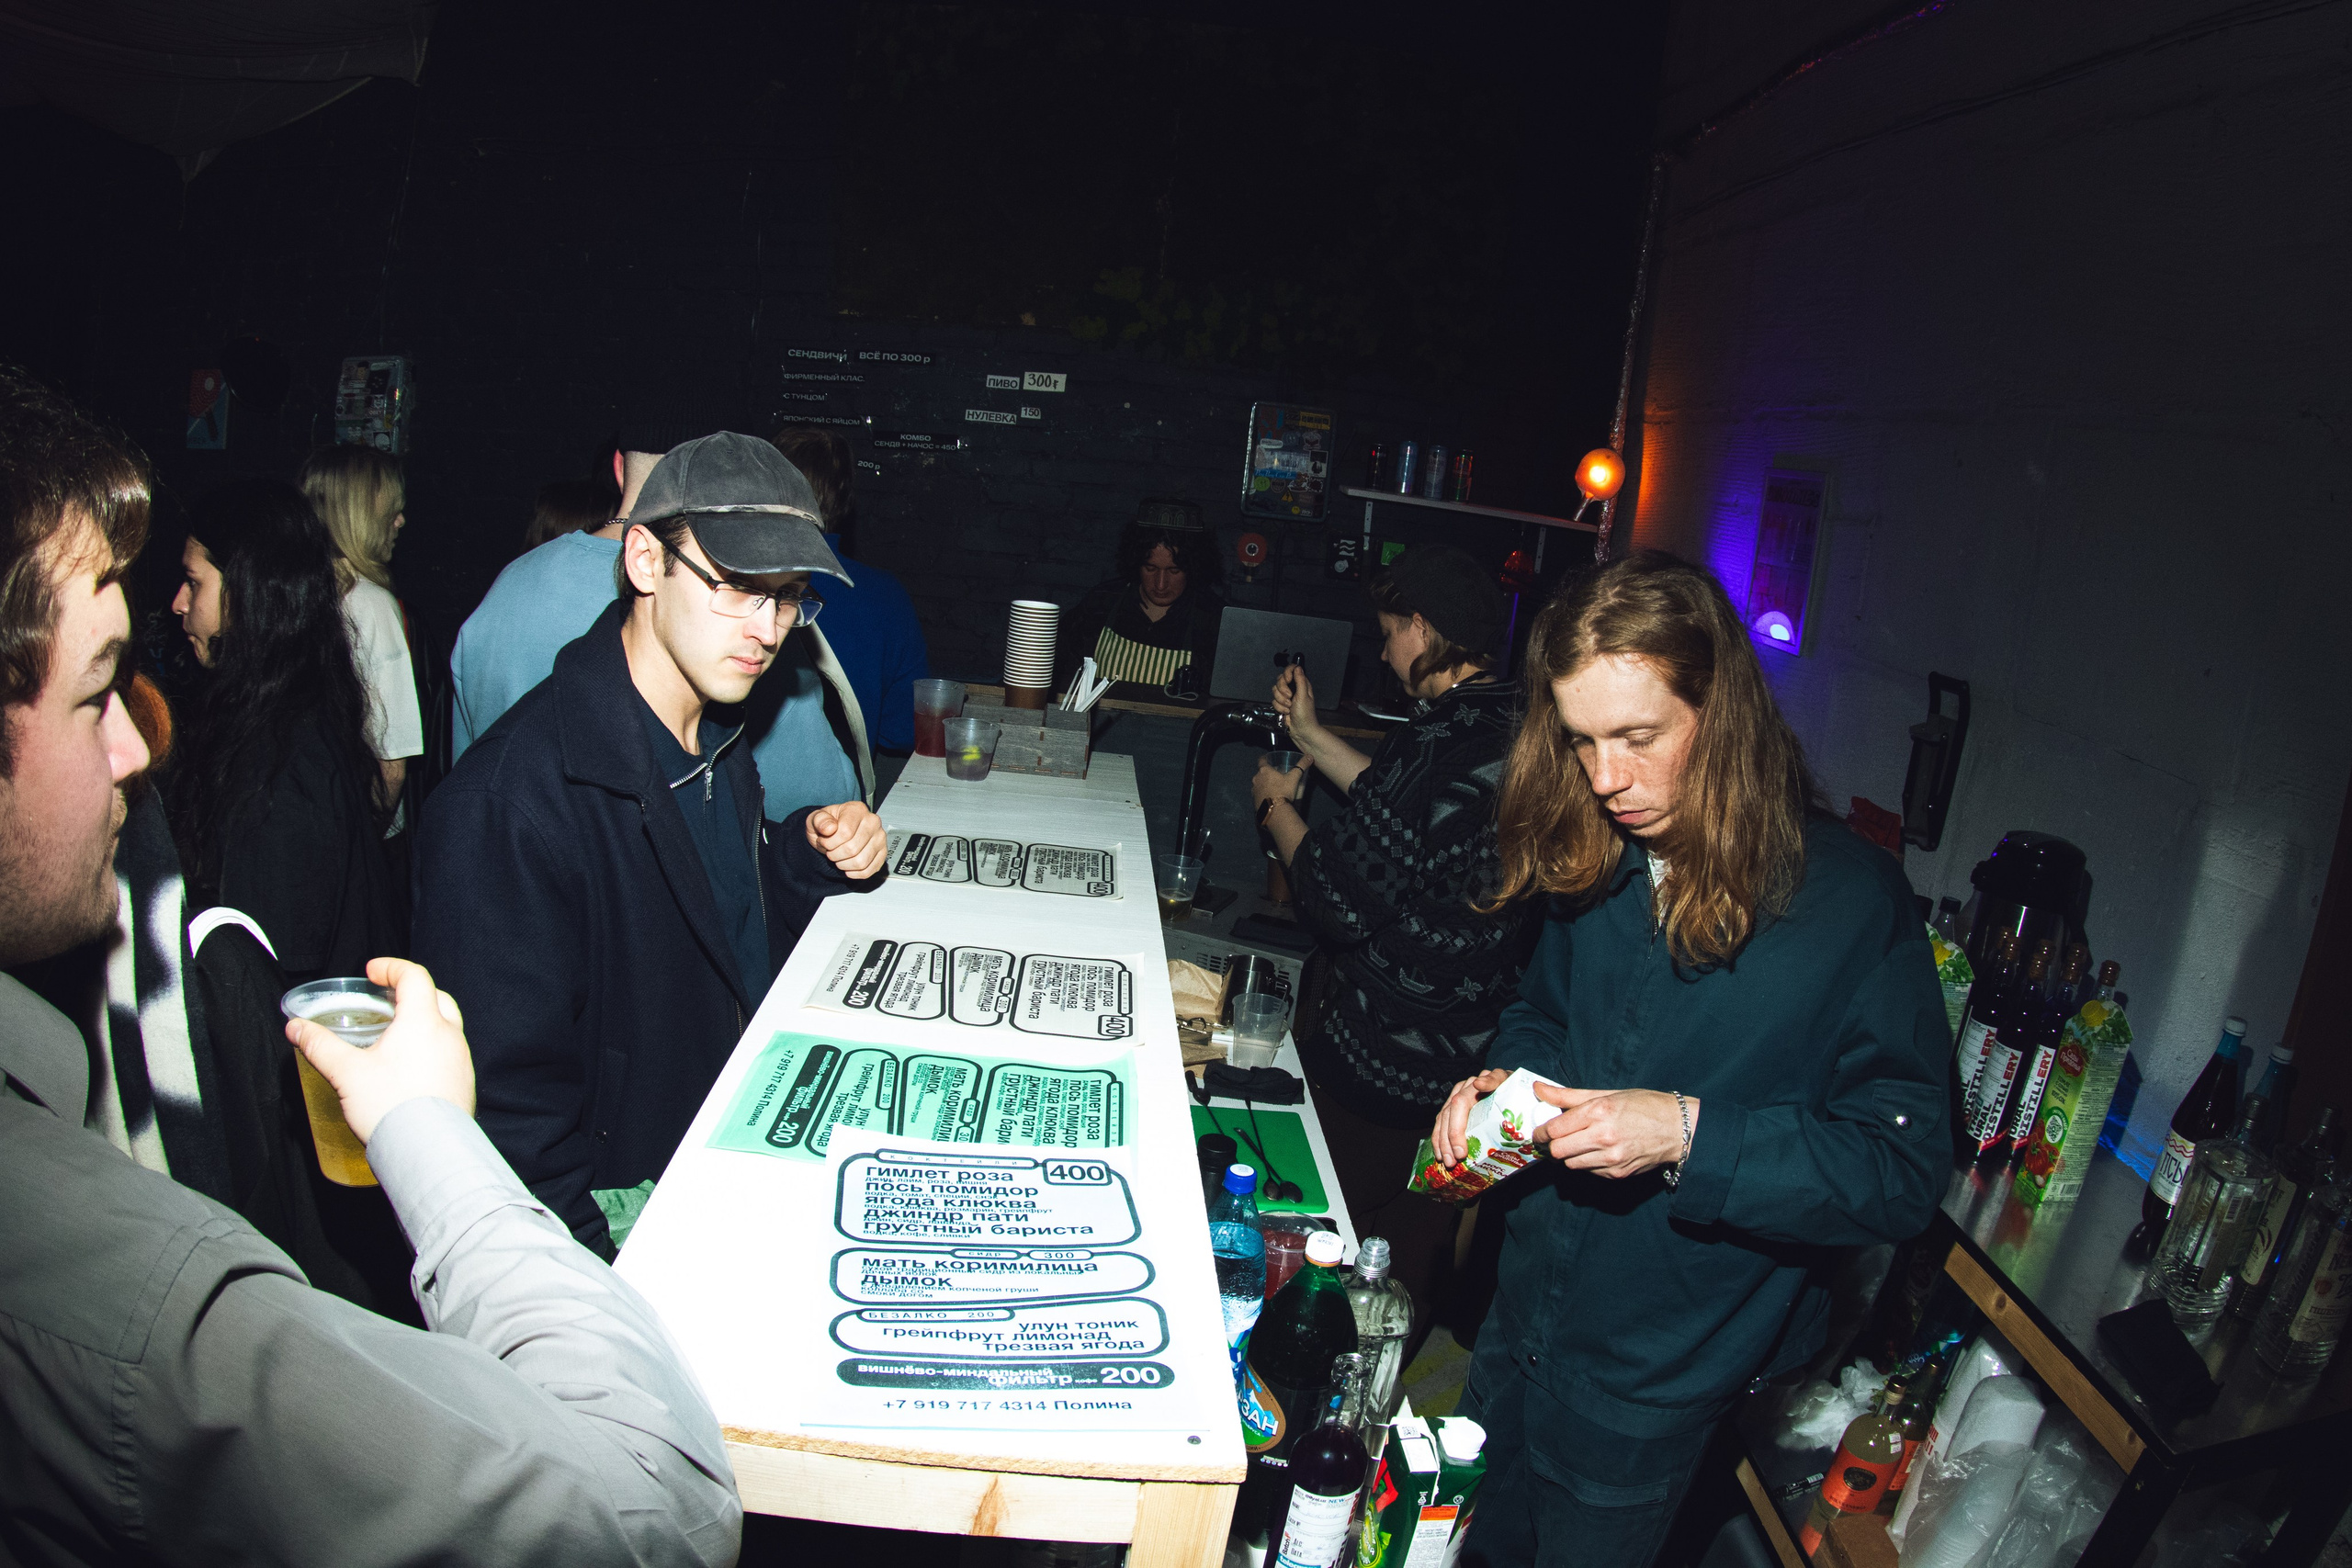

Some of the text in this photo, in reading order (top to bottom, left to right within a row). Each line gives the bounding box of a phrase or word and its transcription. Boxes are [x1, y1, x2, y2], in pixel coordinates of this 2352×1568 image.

[788, 349, 847, 361] СЕНДВИЧИ
[859, 351, 880, 360] ВСЁ
[882, 353, 899, 361] ПО
[900, 354, 921, 362] 300
[784, 373, 840, 382] ФИРМЕННЫЙ
[988, 378, 1018, 389] ПИВО
[791, 393, 825, 401] ТУНЦОМ
[832, 417, 860, 426] ЯЙЦОМ
[967, 408, 1040, 423] НУЛЕВКА 150
[858, 460, 874, 468] 200
[1029, 961, 1047, 1020] грустный бариста
[1066, 964, 1080, 1009] ягода клюква
[1102, 966, 1114, 1008] гимлет роза
[847, 990, 869, 1007] 200
[1049, 988, 1060, 1005] пати
[1081, 981, 1097, 1012] помидор
[1105, 1017, 1125, 1035] 400
[924, 1064, 944, 1095] дымок
[1962, 1029, 1996, 1116] DISTILLERY
[746, 1049, 794, 1126] +7 919 717 4314 Полина
[882, 1062, 895, 1104] БЕЗАЛКО 200
[842, 1063, 875, 1126] грейпфрут лимо
[1983, 1051, 2019, 1141] DISTILLERY
[2018, 1050, 2052, 1139] DISTILLERY
[830, 1092, 850, 1123] трезвая
[937, 1067, 968, 1143] мать коримили
[994, 1073, 1022, 1145] грустный бари
[1021, 1075, 1041, 1138] джиндр пати
[1042, 1077, 1062, 1145] ягода клюква
[1060, 1079, 1082, 1148] пось помидор
[1084, 1079, 1102, 1141] гимлет роза
[772, 1086, 808, 1144] фильтр 200
[854, 1108, 871, 1127] улун
[1968, 1110, 1982, 1132] THE
[1973, 1103, 1993, 1138] URAL
[2008, 1100, 2027, 1137] URAL
[958, 1132, 970, 1143] 30
[865, 1167, 1014, 1183] гимлет роза
[1049, 1165, 1104, 1181] 400
[2159, 1152, 2190, 1185] ПСЫ
[865, 1182, 1038, 1198] пось помидор
[865, 1196, 1036, 1209] ягода клюква
[864, 1209, 1029, 1224] джиндр пати
[864, 1222, 1094, 1237] грустный бариста
[1044, 1251, 1075, 1259] 300
[863, 1258, 1099, 1274] мать коримилица
[861, 1274, 954, 1287] дымок
[967, 1311, 995, 1319] 200
[882, 1327, 1112, 1343] грейпфрут лимонад
[1018, 1321, 1139, 1333] улун тоник
[982, 1340, 1145, 1353] трезвая ягода
[857, 1364, 1053, 1378] вишнёво-миндальный
[988, 1374, 1073, 1387] фильтр
[1101, 1367, 1161, 1385] 200
[882, 1400, 1132, 1411] +7 919 717 4314 Полина
